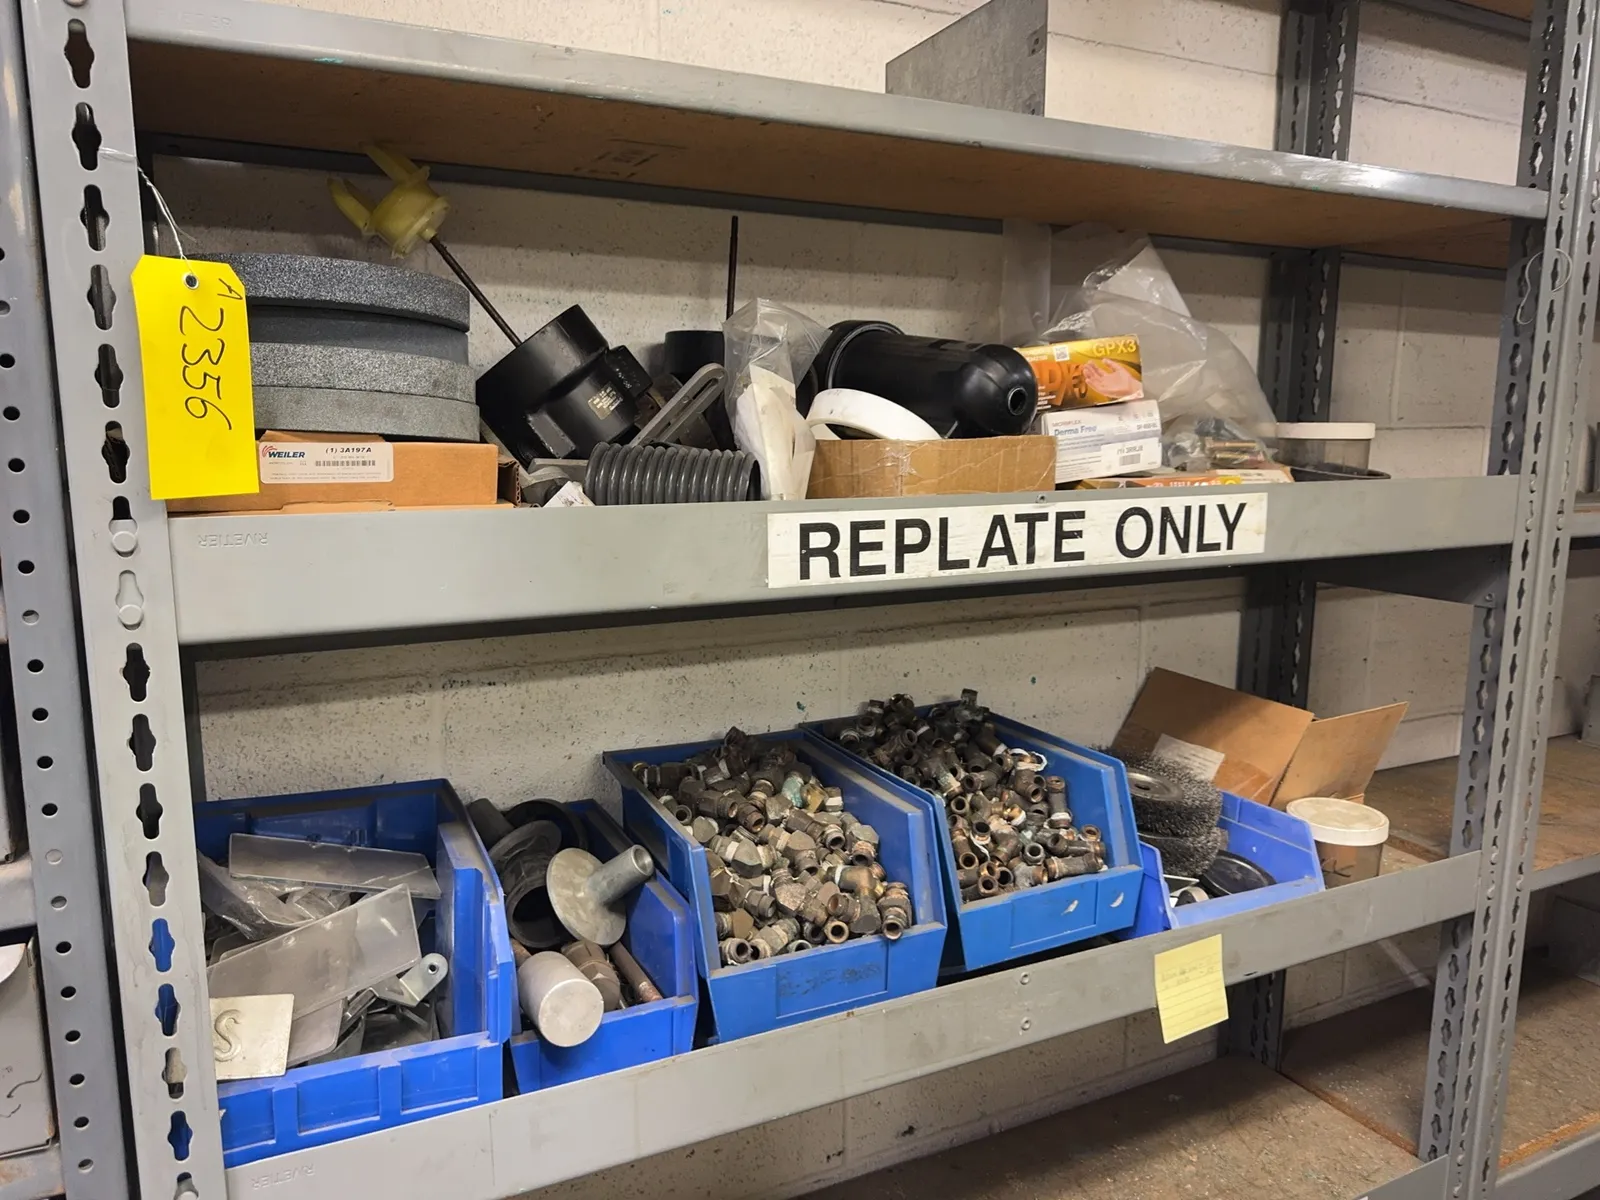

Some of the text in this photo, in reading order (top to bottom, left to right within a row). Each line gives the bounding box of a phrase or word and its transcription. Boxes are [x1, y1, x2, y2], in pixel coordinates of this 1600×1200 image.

[1092, 339, 1137, 356] GPX3
[179, 304, 233, 431] 2356
[1054, 425, 1098, 436] Derma Free
[268, 451, 306, 459] WEILER
[799, 502, 1248, 581] REPLATE ONLY
